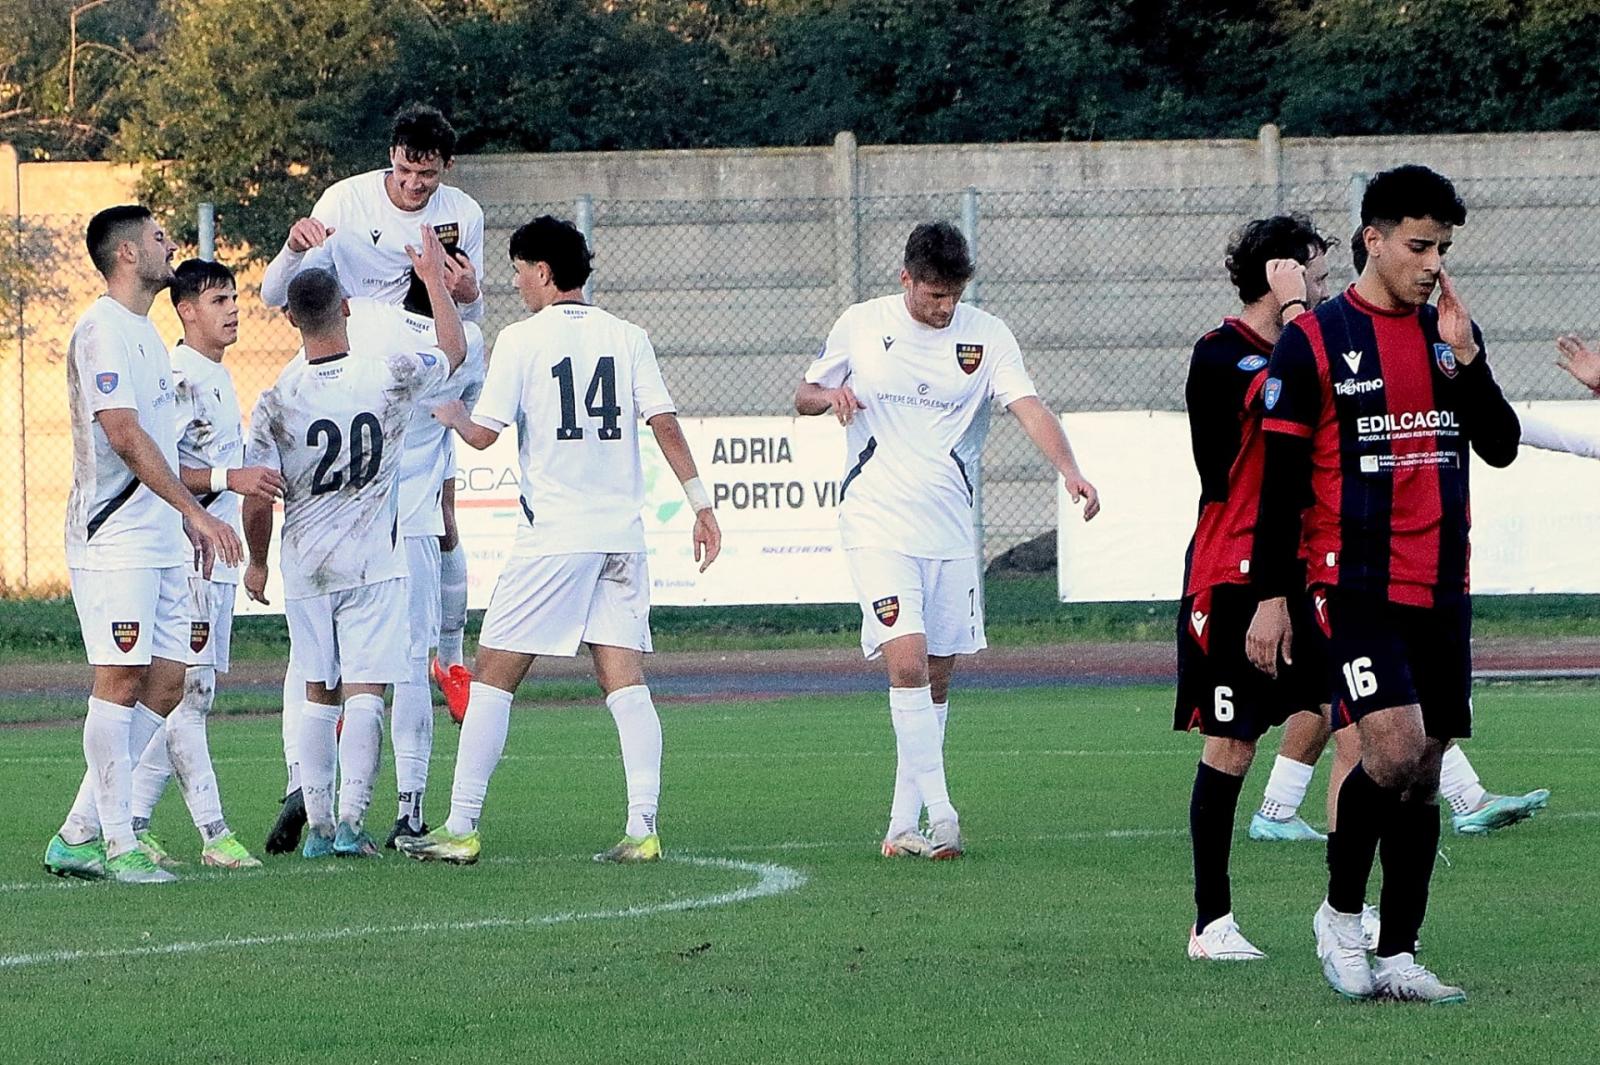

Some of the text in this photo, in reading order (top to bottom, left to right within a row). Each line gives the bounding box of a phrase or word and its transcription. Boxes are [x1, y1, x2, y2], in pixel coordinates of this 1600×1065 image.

[551, 356, 622, 440] 14
[1356, 410, 1460, 434] EDILCAGOL
[306, 411, 384, 496] 20
[712, 437, 792, 464] ADRIA
[714, 481, 836, 509] PORTO VI
[1342, 656, 1379, 702] 16
[1214, 686, 1235, 722] 6
